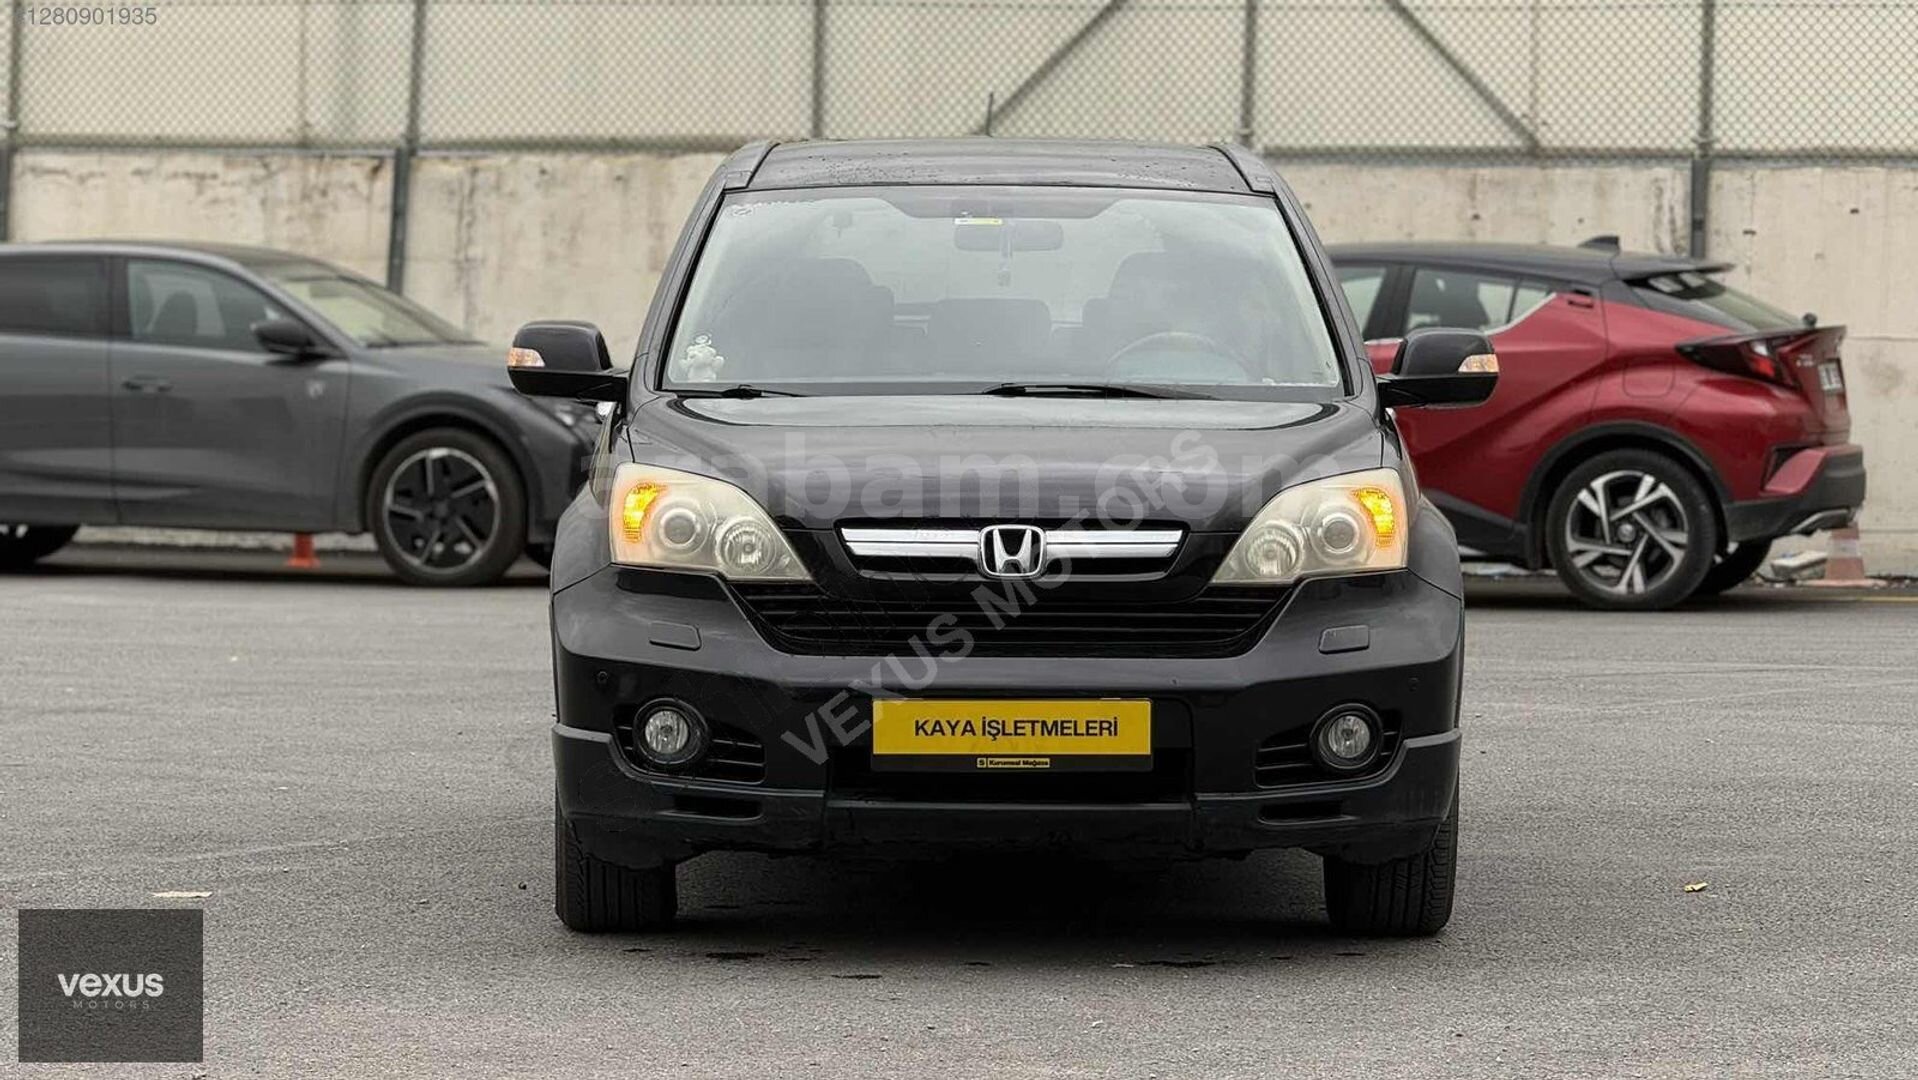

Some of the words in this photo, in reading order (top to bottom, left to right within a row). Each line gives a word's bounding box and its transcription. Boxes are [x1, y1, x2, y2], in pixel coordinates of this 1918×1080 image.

[914, 719, 977, 737] KAYA
[981, 716, 1118, 741] İŞLETMELERİ
[989, 759, 1021, 767] Kurumsal
